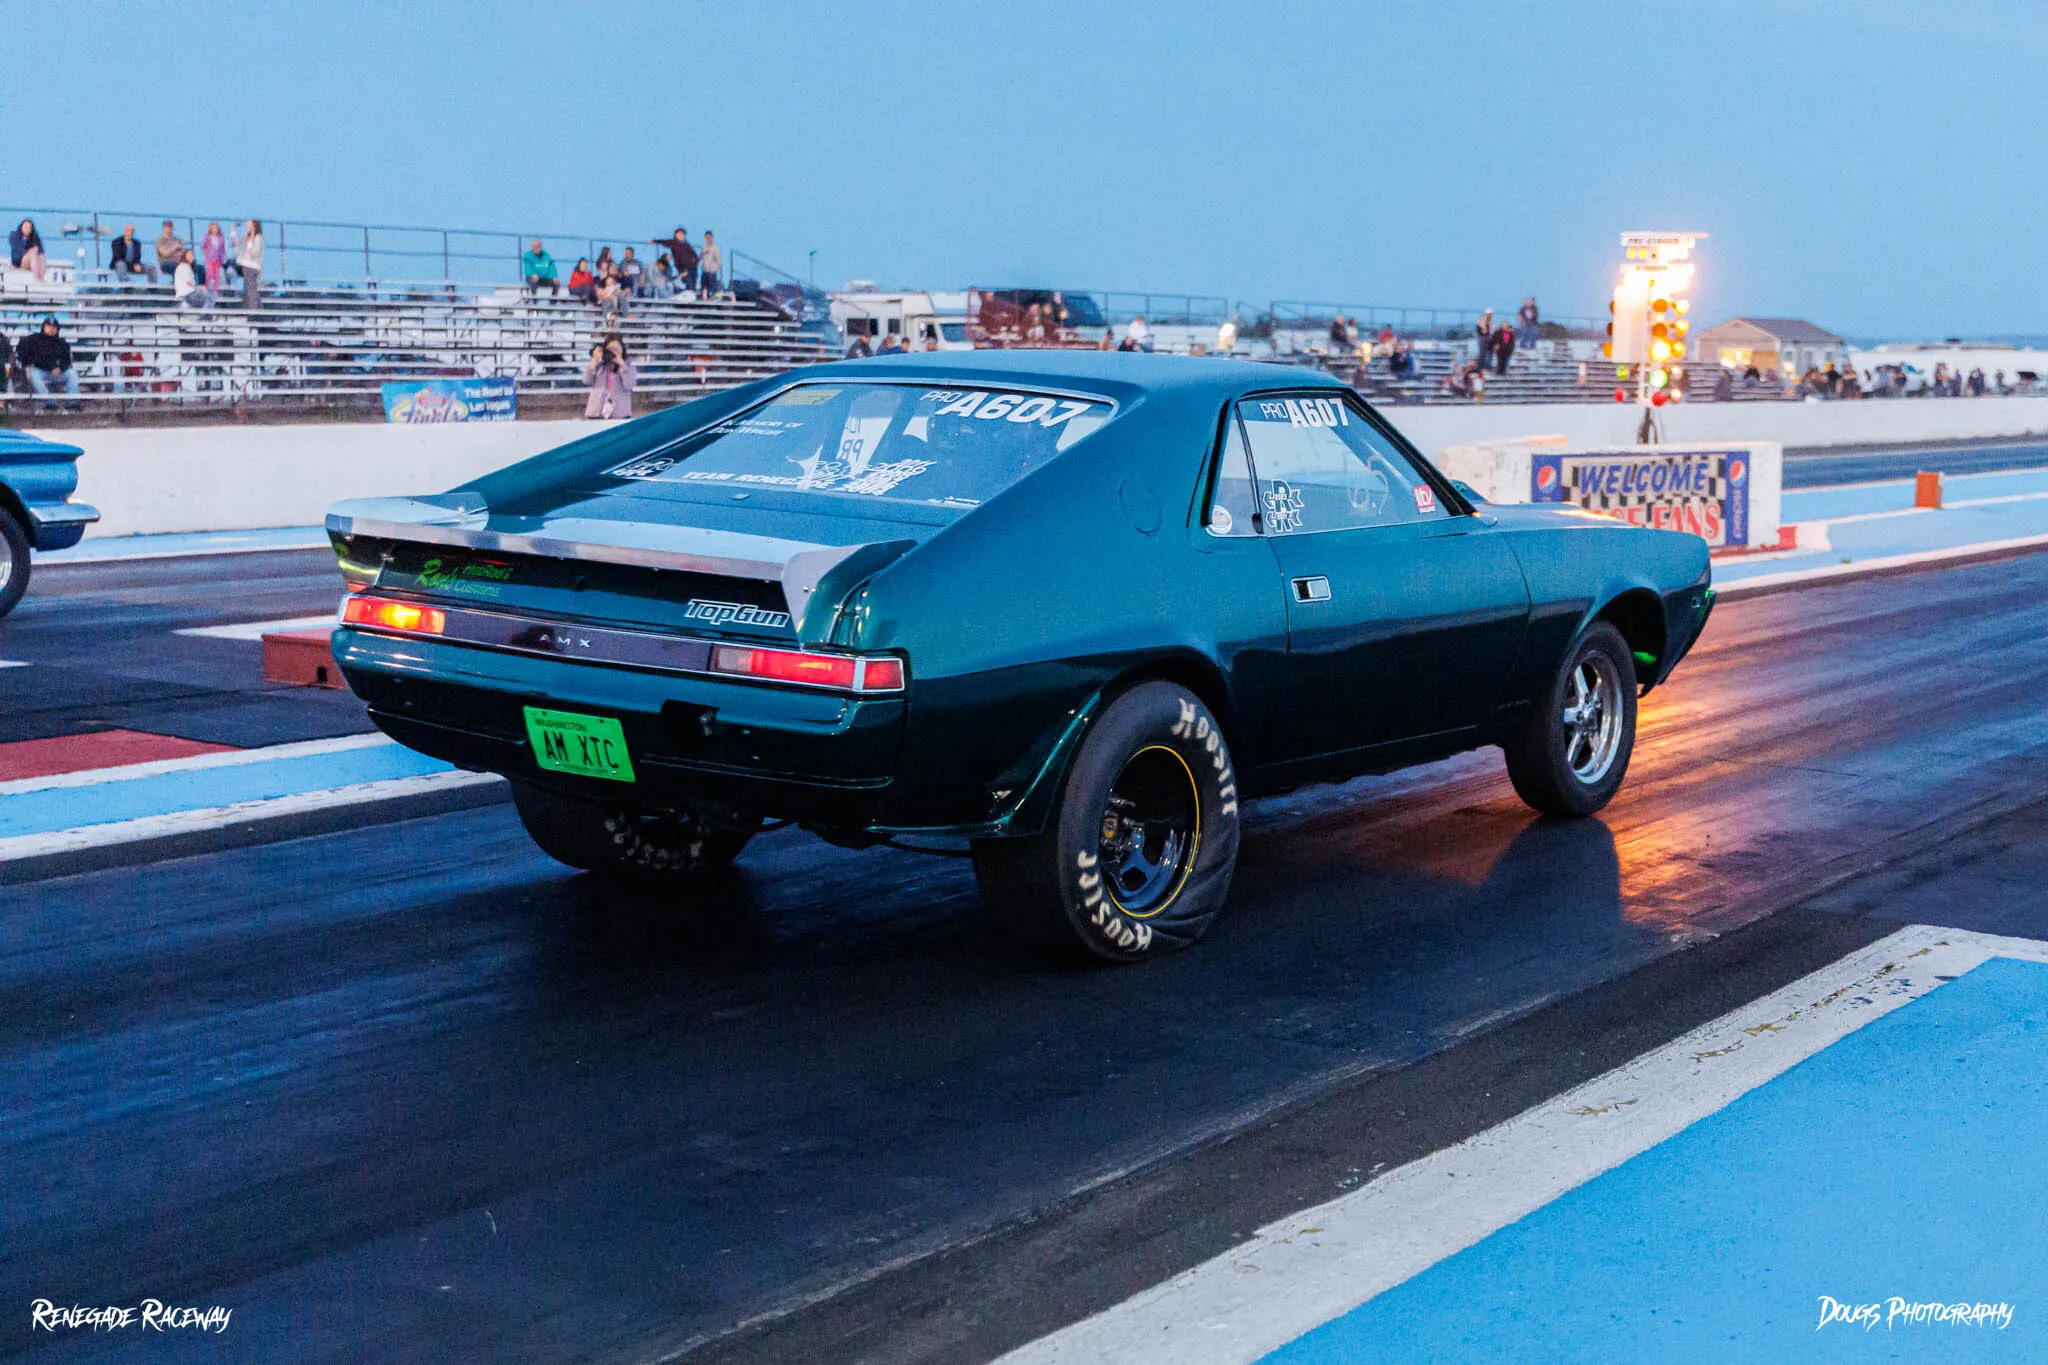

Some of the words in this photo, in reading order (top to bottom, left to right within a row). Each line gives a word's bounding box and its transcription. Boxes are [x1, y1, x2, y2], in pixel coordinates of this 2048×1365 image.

[920, 391, 962, 403] PRO
[935, 392, 1092, 428] A607
[1260, 402, 1288, 419] PRO
[1284, 398, 1349, 428] A607
[1580, 462, 1709, 495] WELCOME
[1653, 503, 1721, 540] FANS
[684, 598, 790, 628] TopGun
[543, 729, 570, 762] AM
[576, 734, 620, 769] XTC
